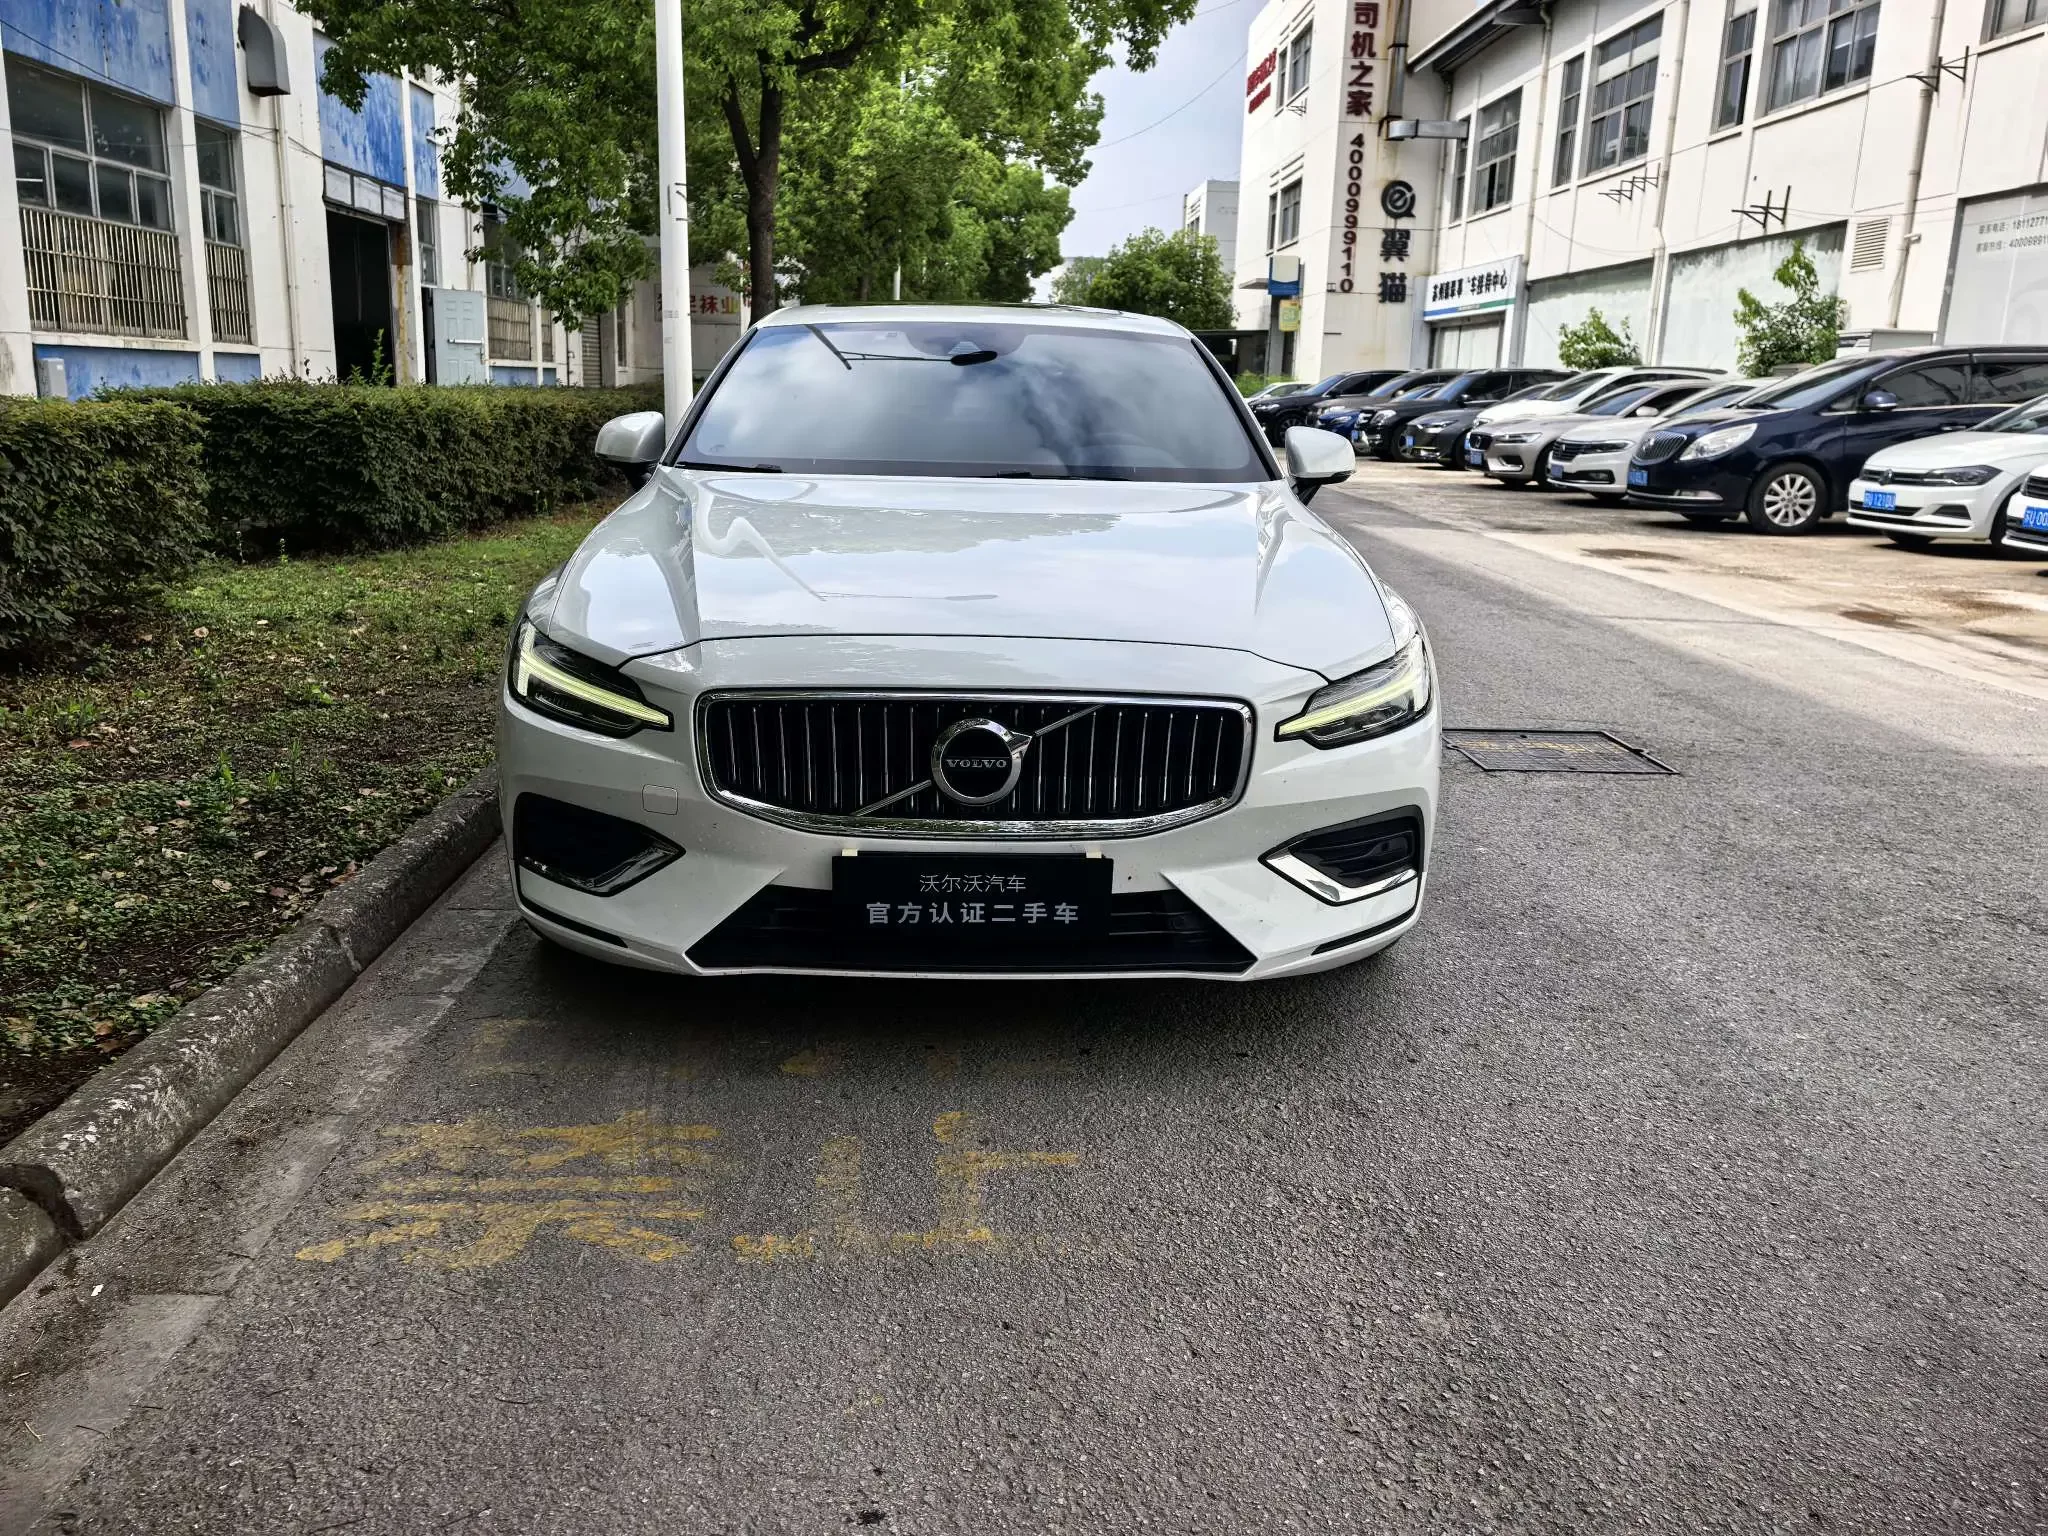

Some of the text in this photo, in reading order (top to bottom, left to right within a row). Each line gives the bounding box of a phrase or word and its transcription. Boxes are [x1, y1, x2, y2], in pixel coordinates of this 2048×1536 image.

[1346, 2, 1379, 117] 司机之家
[1340, 133, 1363, 293] 4000999110
[946, 759, 1007, 768] VOLVO
[919, 874, 1027, 893] 沃尔沃汽车
[866, 901, 1079, 924] 官方认证二手车
